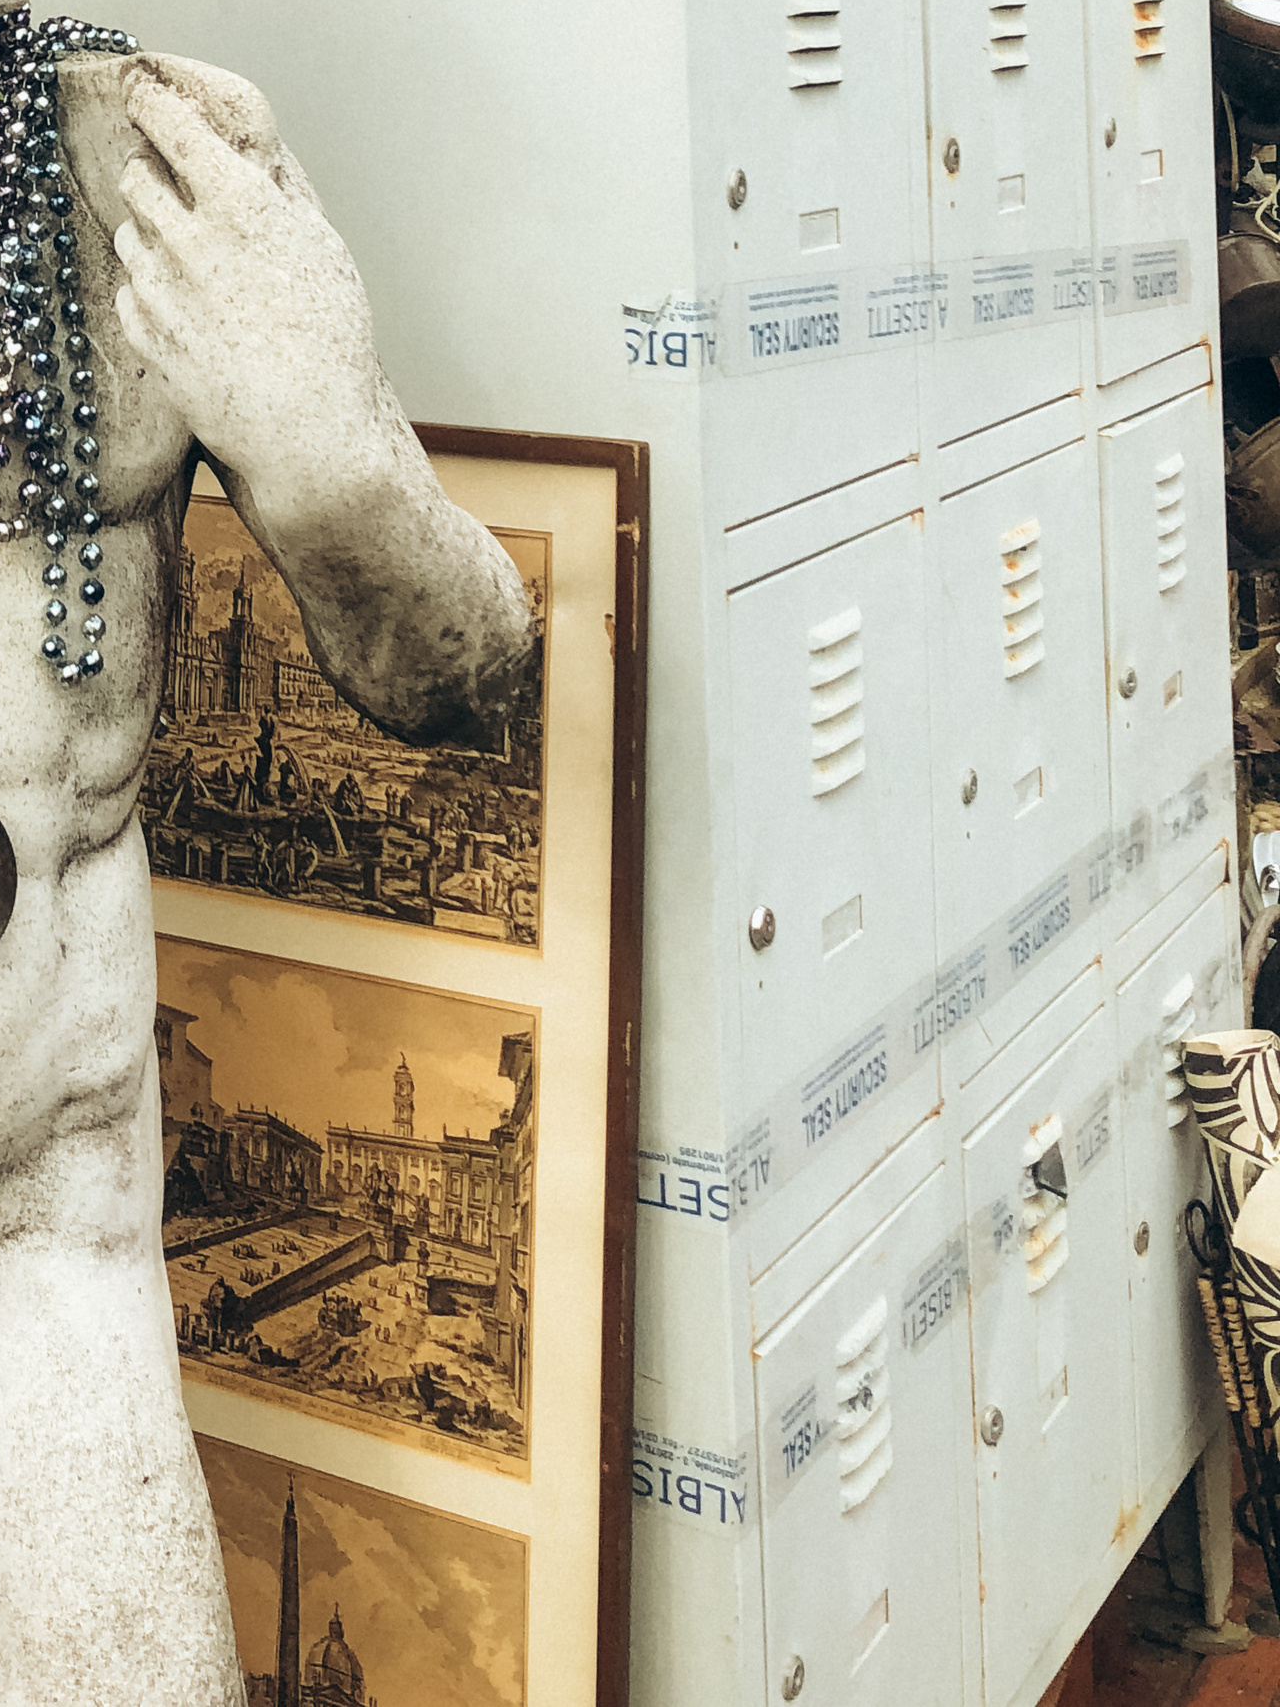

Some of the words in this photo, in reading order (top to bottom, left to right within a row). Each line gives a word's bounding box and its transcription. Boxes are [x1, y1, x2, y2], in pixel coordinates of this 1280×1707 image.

[748, 321, 781, 358] SEAL
[783, 311, 839, 353] SECURITY
[834, 1051, 887, 1123] SECURITY
[801, 1097, 832, 1148] SEAL
